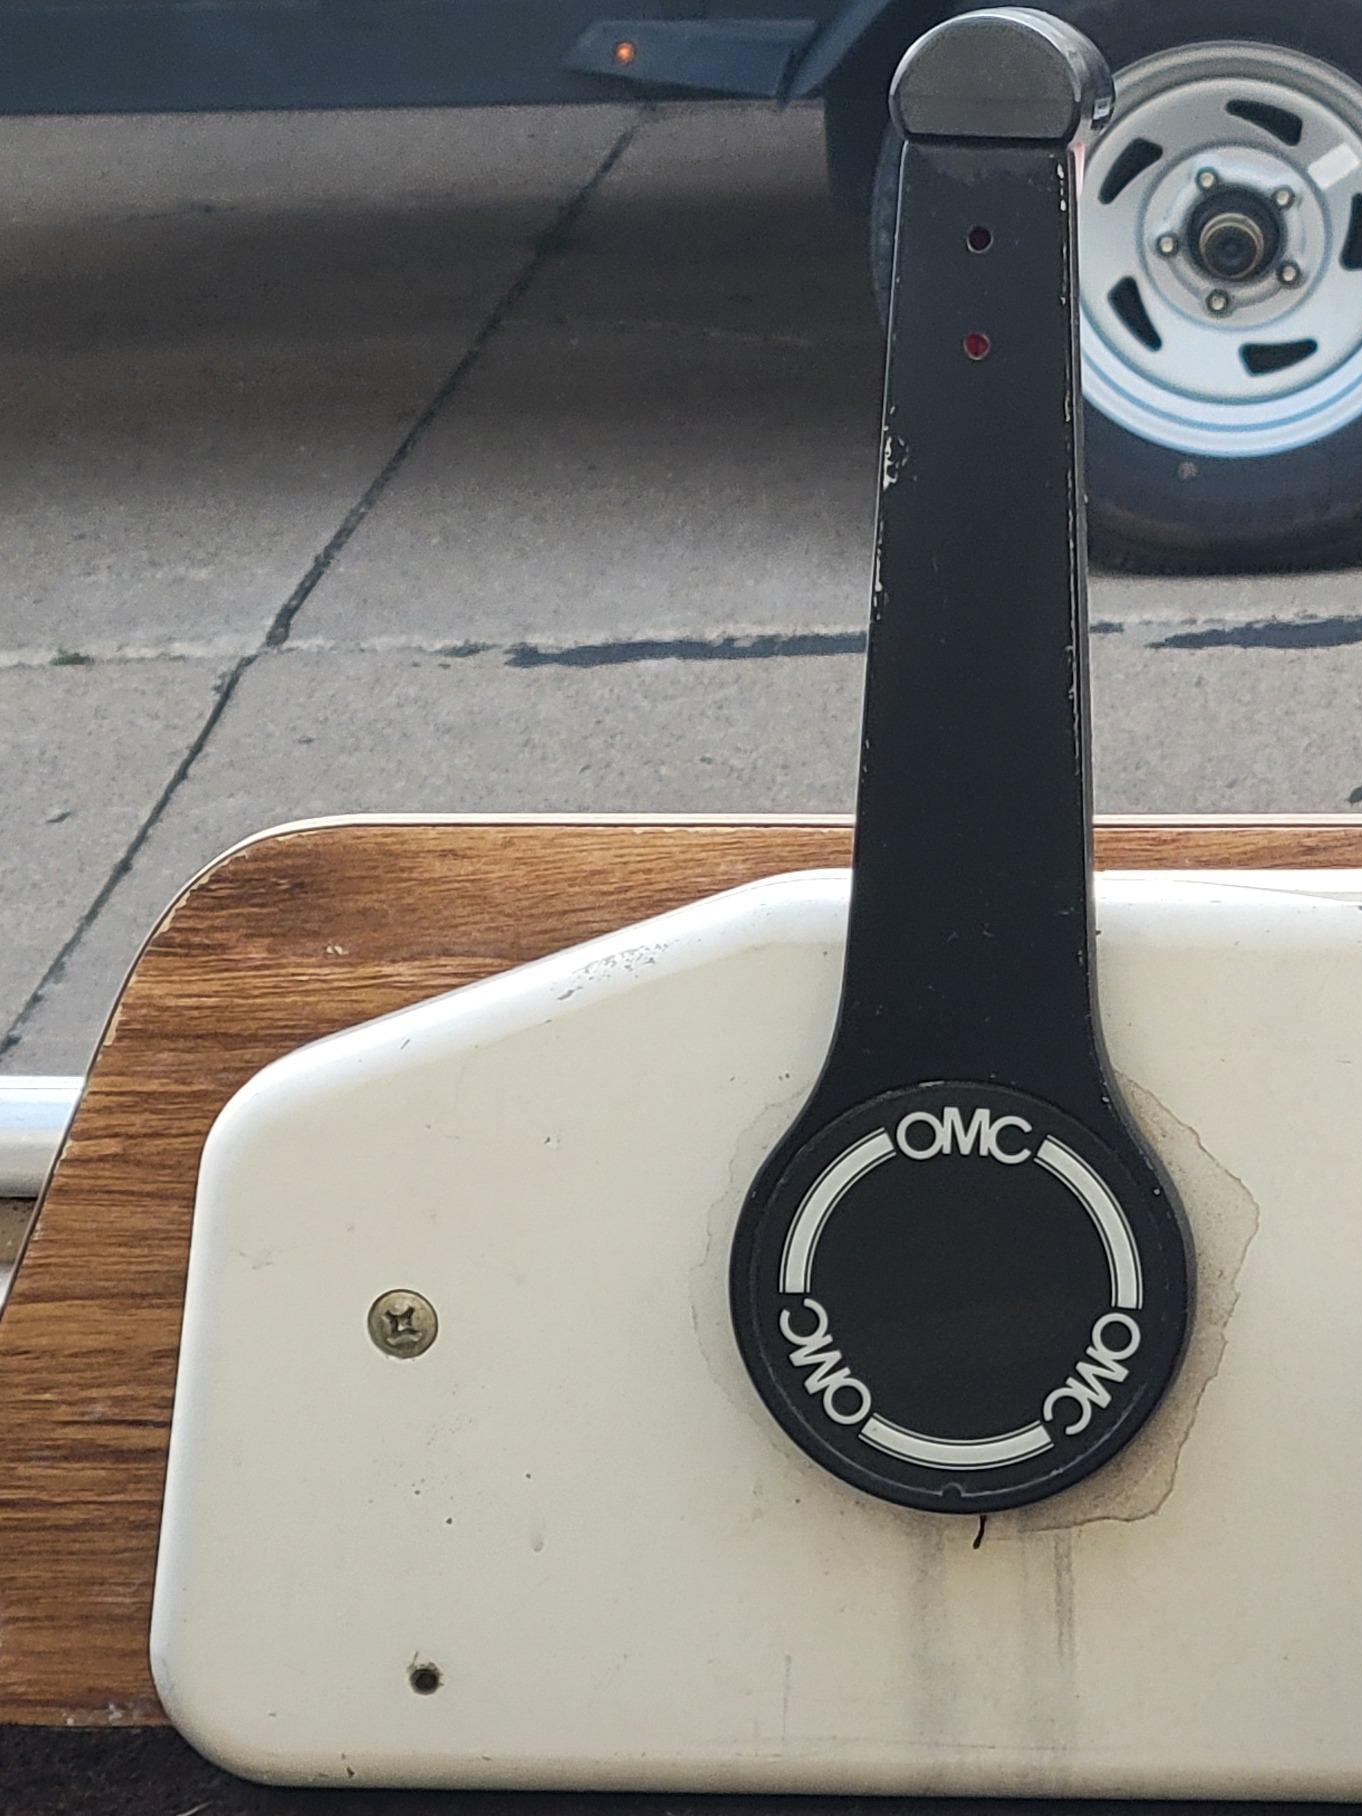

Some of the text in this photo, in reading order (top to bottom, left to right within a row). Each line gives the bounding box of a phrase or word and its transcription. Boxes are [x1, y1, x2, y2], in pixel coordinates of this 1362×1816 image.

[896, 1106, 1032, 1164] OMC
[779, 1298, 872, 1425] OMC
[1043, 1312, 1141, 1435] OMC
